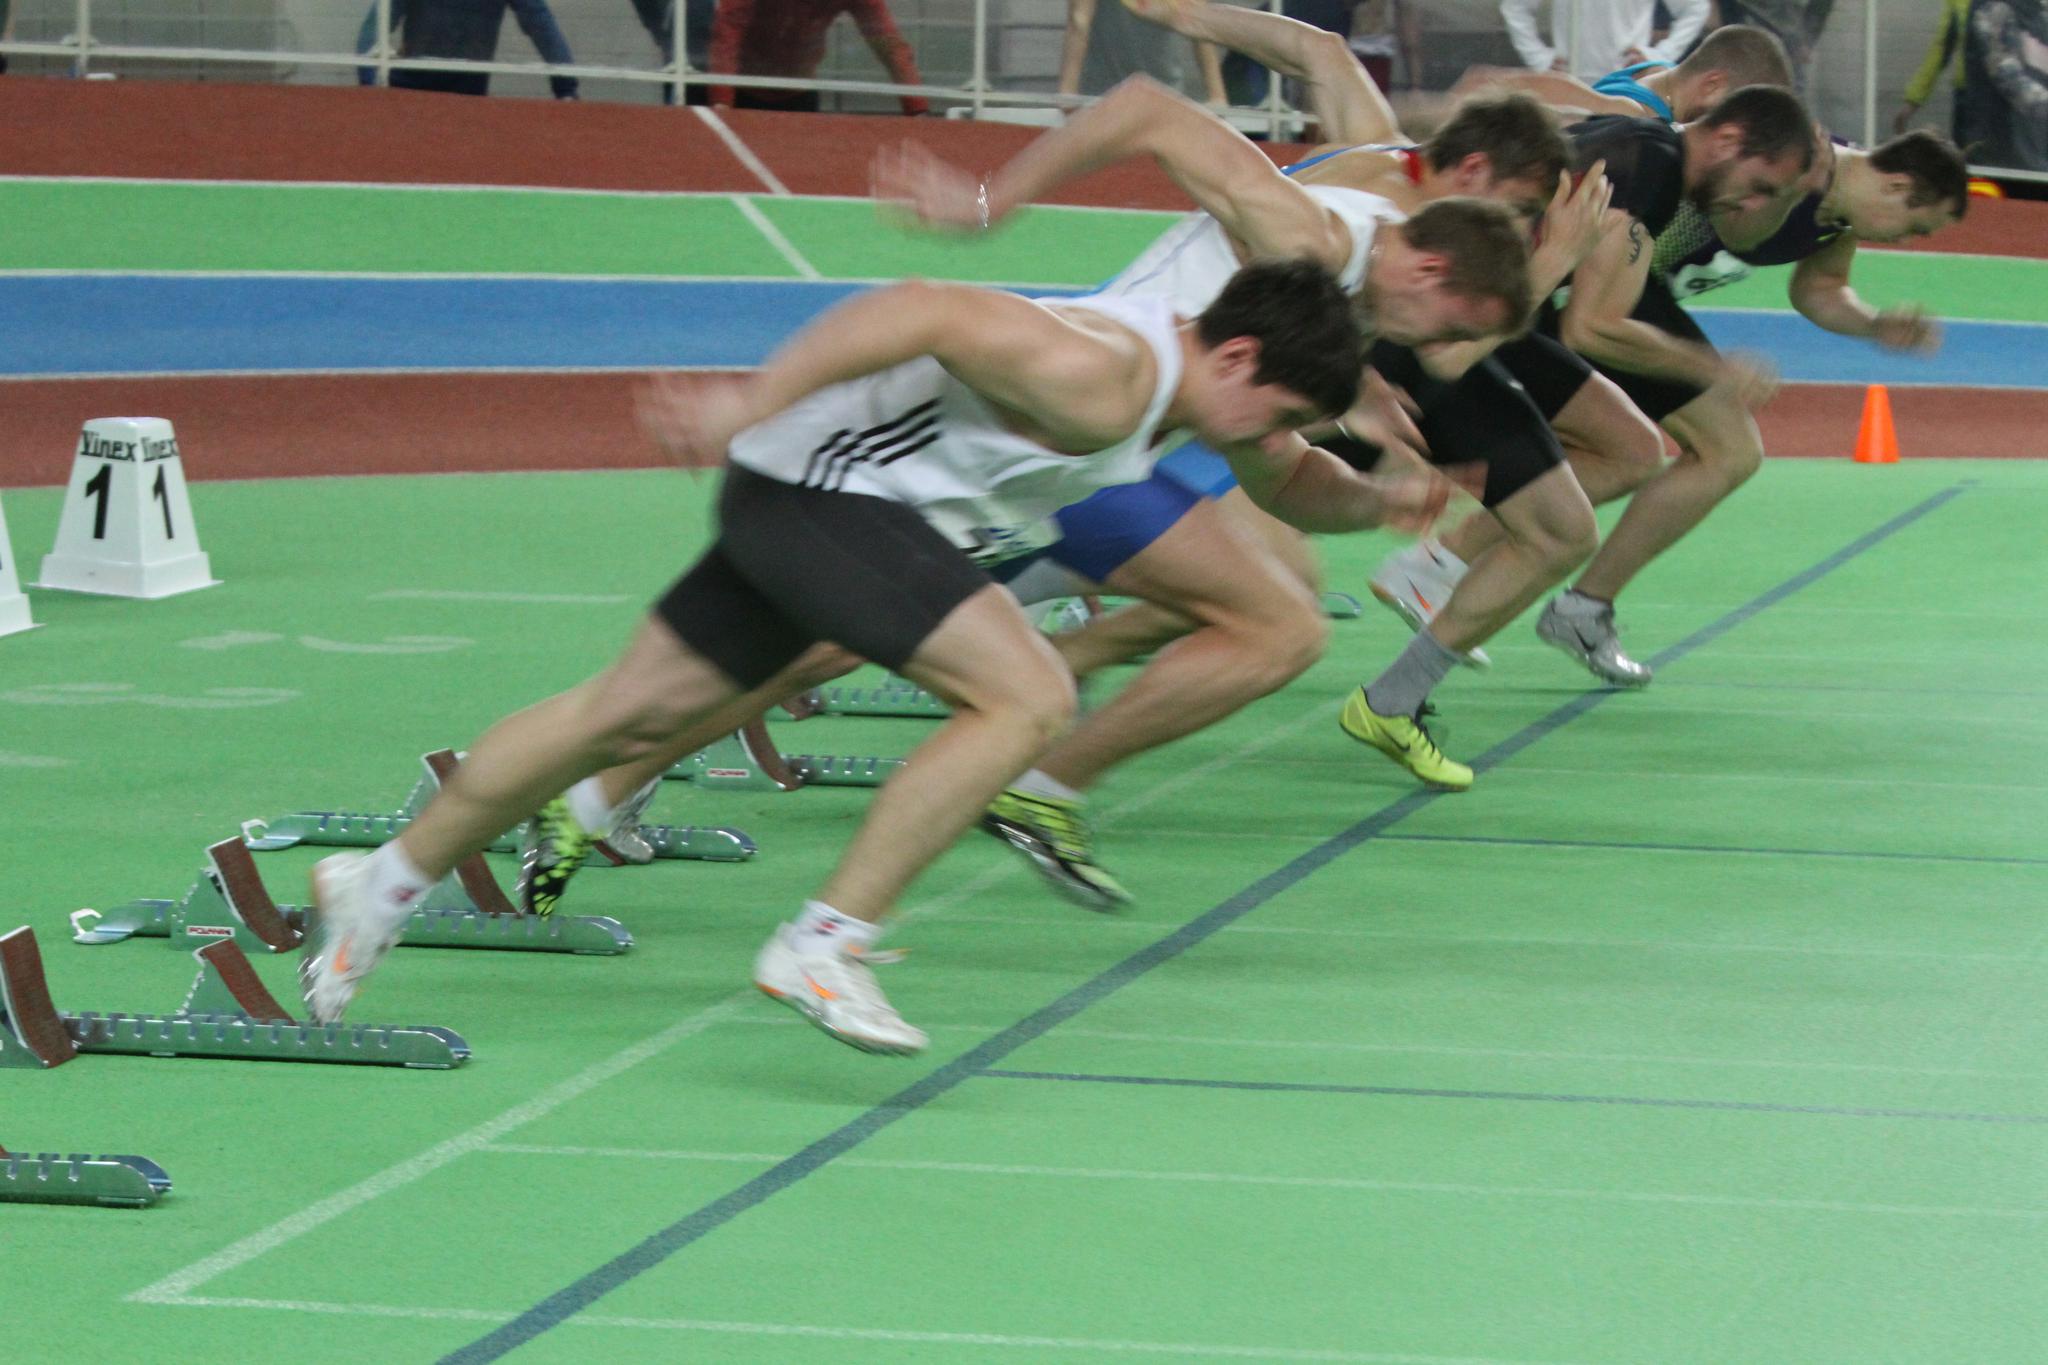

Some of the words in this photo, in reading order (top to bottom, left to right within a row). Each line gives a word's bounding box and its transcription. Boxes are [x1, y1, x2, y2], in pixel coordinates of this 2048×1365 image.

[82, 430, 138, 462] Vinex
[85, 463, 111, 540] 1
[153, 464, 174, 540] 1
